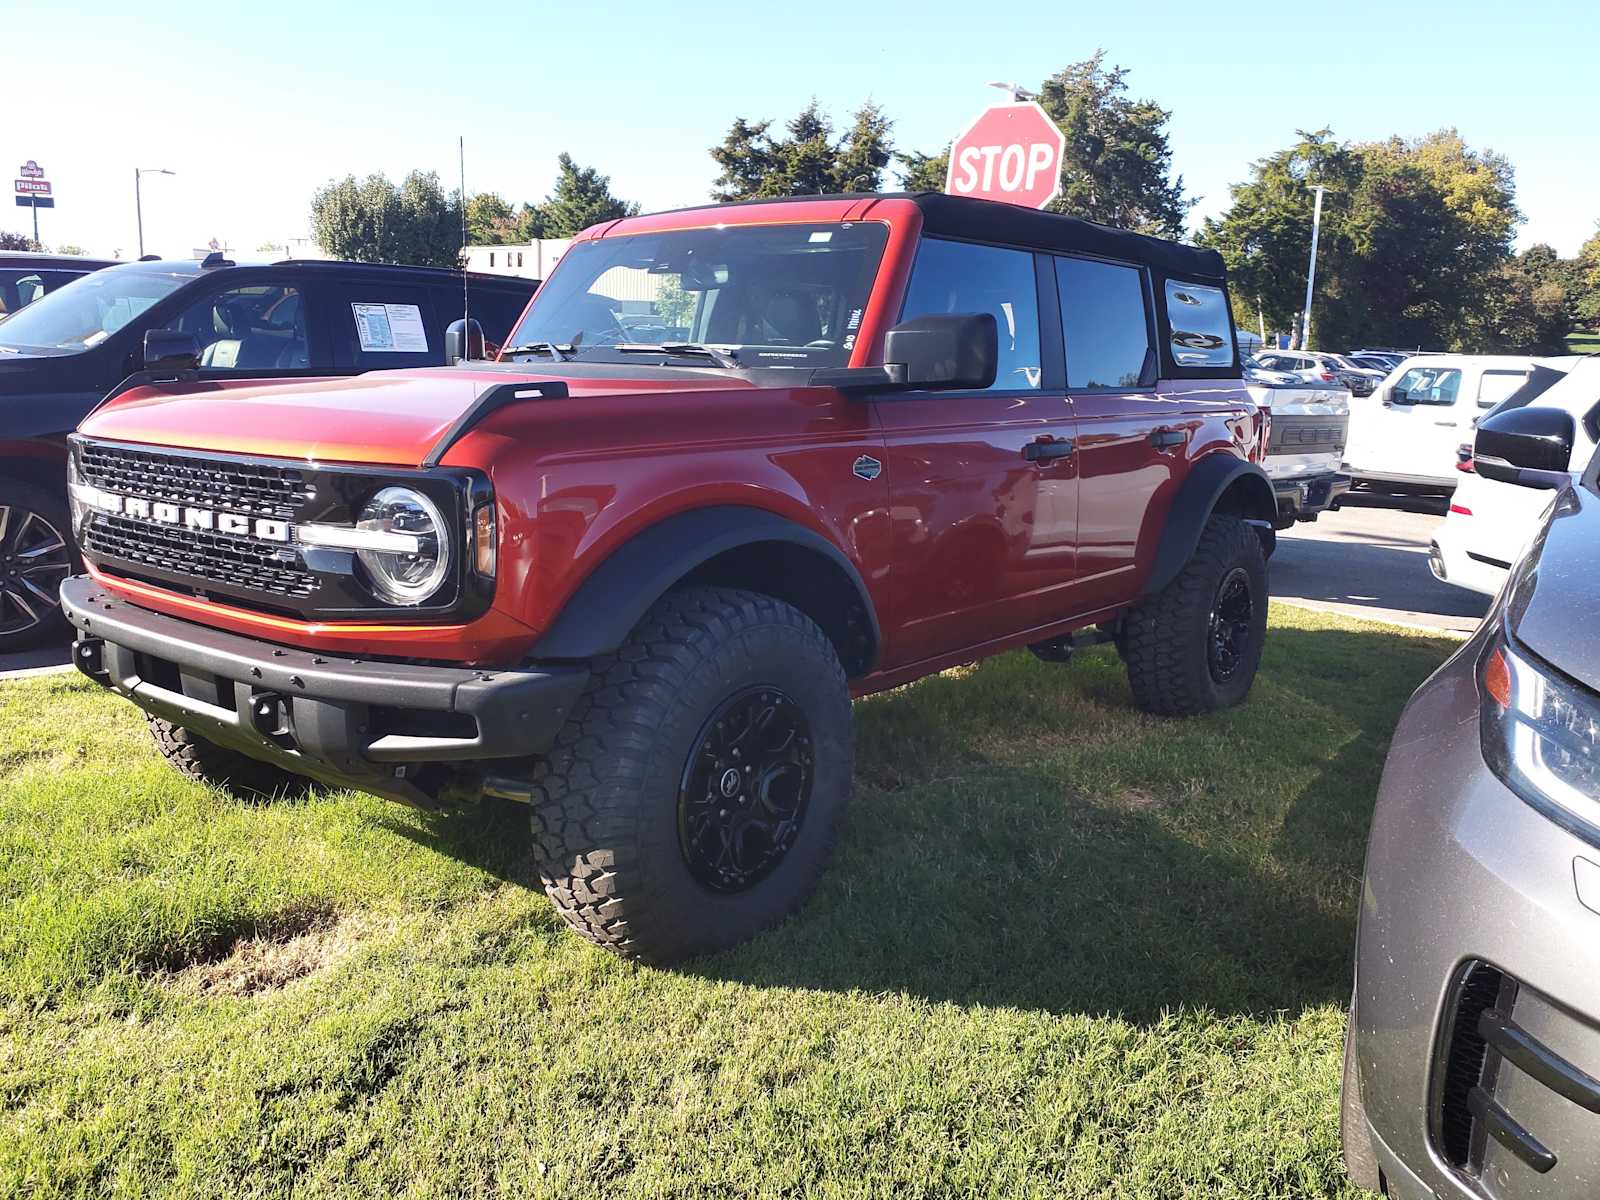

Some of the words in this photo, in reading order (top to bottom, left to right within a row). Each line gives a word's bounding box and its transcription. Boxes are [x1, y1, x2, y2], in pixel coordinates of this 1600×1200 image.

[22, 168, 42, 177] Wdy's
[954, 143, 1054, 193] STOP
[98, 493, 290, 542] BRONCO
